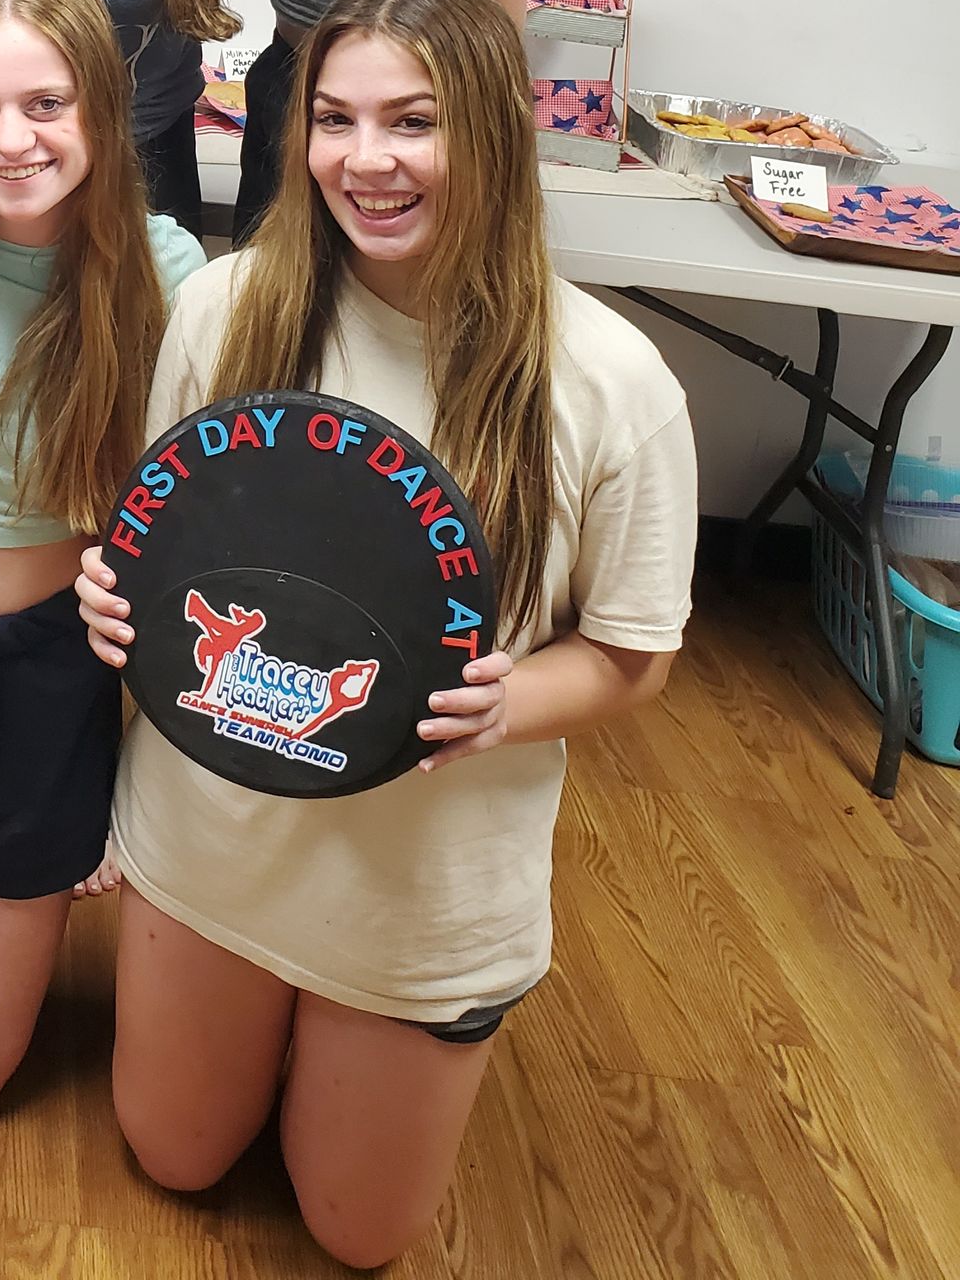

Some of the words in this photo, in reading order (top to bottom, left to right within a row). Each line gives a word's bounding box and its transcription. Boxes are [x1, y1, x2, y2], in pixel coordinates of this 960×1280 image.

[763, 161, 804, 185] Sugar
[769, 180, 805, 197] Free
[110, 442, 191, 559] FIRST
[197, 407, 286, 456] DAY
[307, 413, 367, 455] OF
[366, 435, 480, 582] DANCE
[441, 596, 483, 659] AT
[231, 654, 240, 671] and
[239, 642, 329, 714] Tracey
[216, 652, 311, 724] Heather's
[179, 695, 227, 716] DANCE
[229, 710, 294, 737] SYNERGY
[217, 717, 275, 746] TEAM
[279, 739, 345, 769] KOMO
